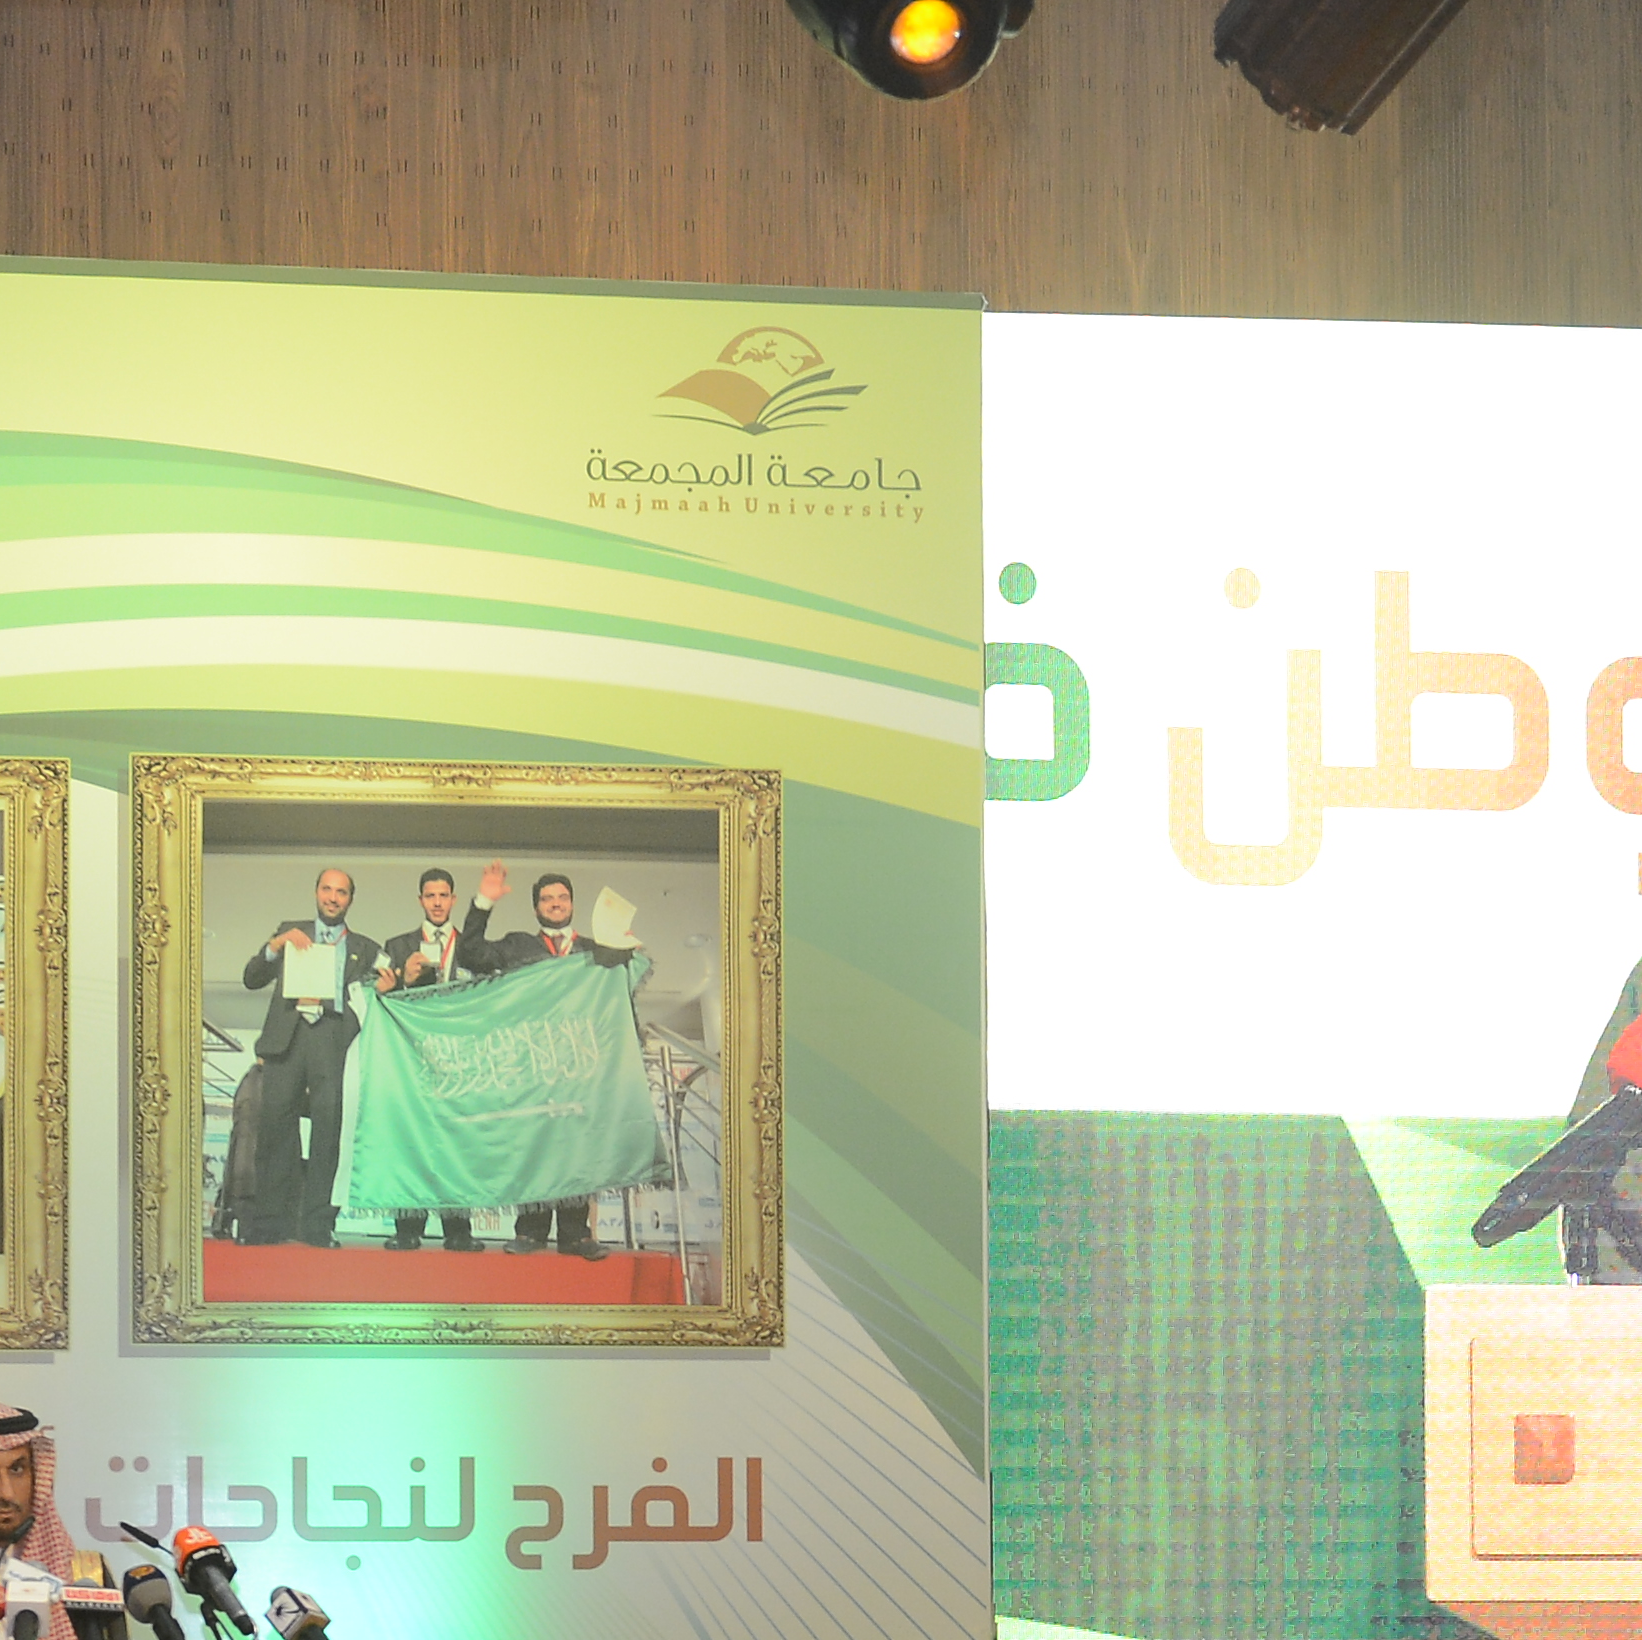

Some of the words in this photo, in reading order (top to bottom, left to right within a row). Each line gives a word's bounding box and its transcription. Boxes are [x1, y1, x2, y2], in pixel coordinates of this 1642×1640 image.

[586, 448, 753, 493] المجمعة
[766, 454, 922, 499] جامعة
[588, 492, 731, 515] Majmaah
[744, 498, 925, 523] University
[83, 1454, 477, 1572] لنجاحات
[503, 1455, 765, 1572] الفرح
